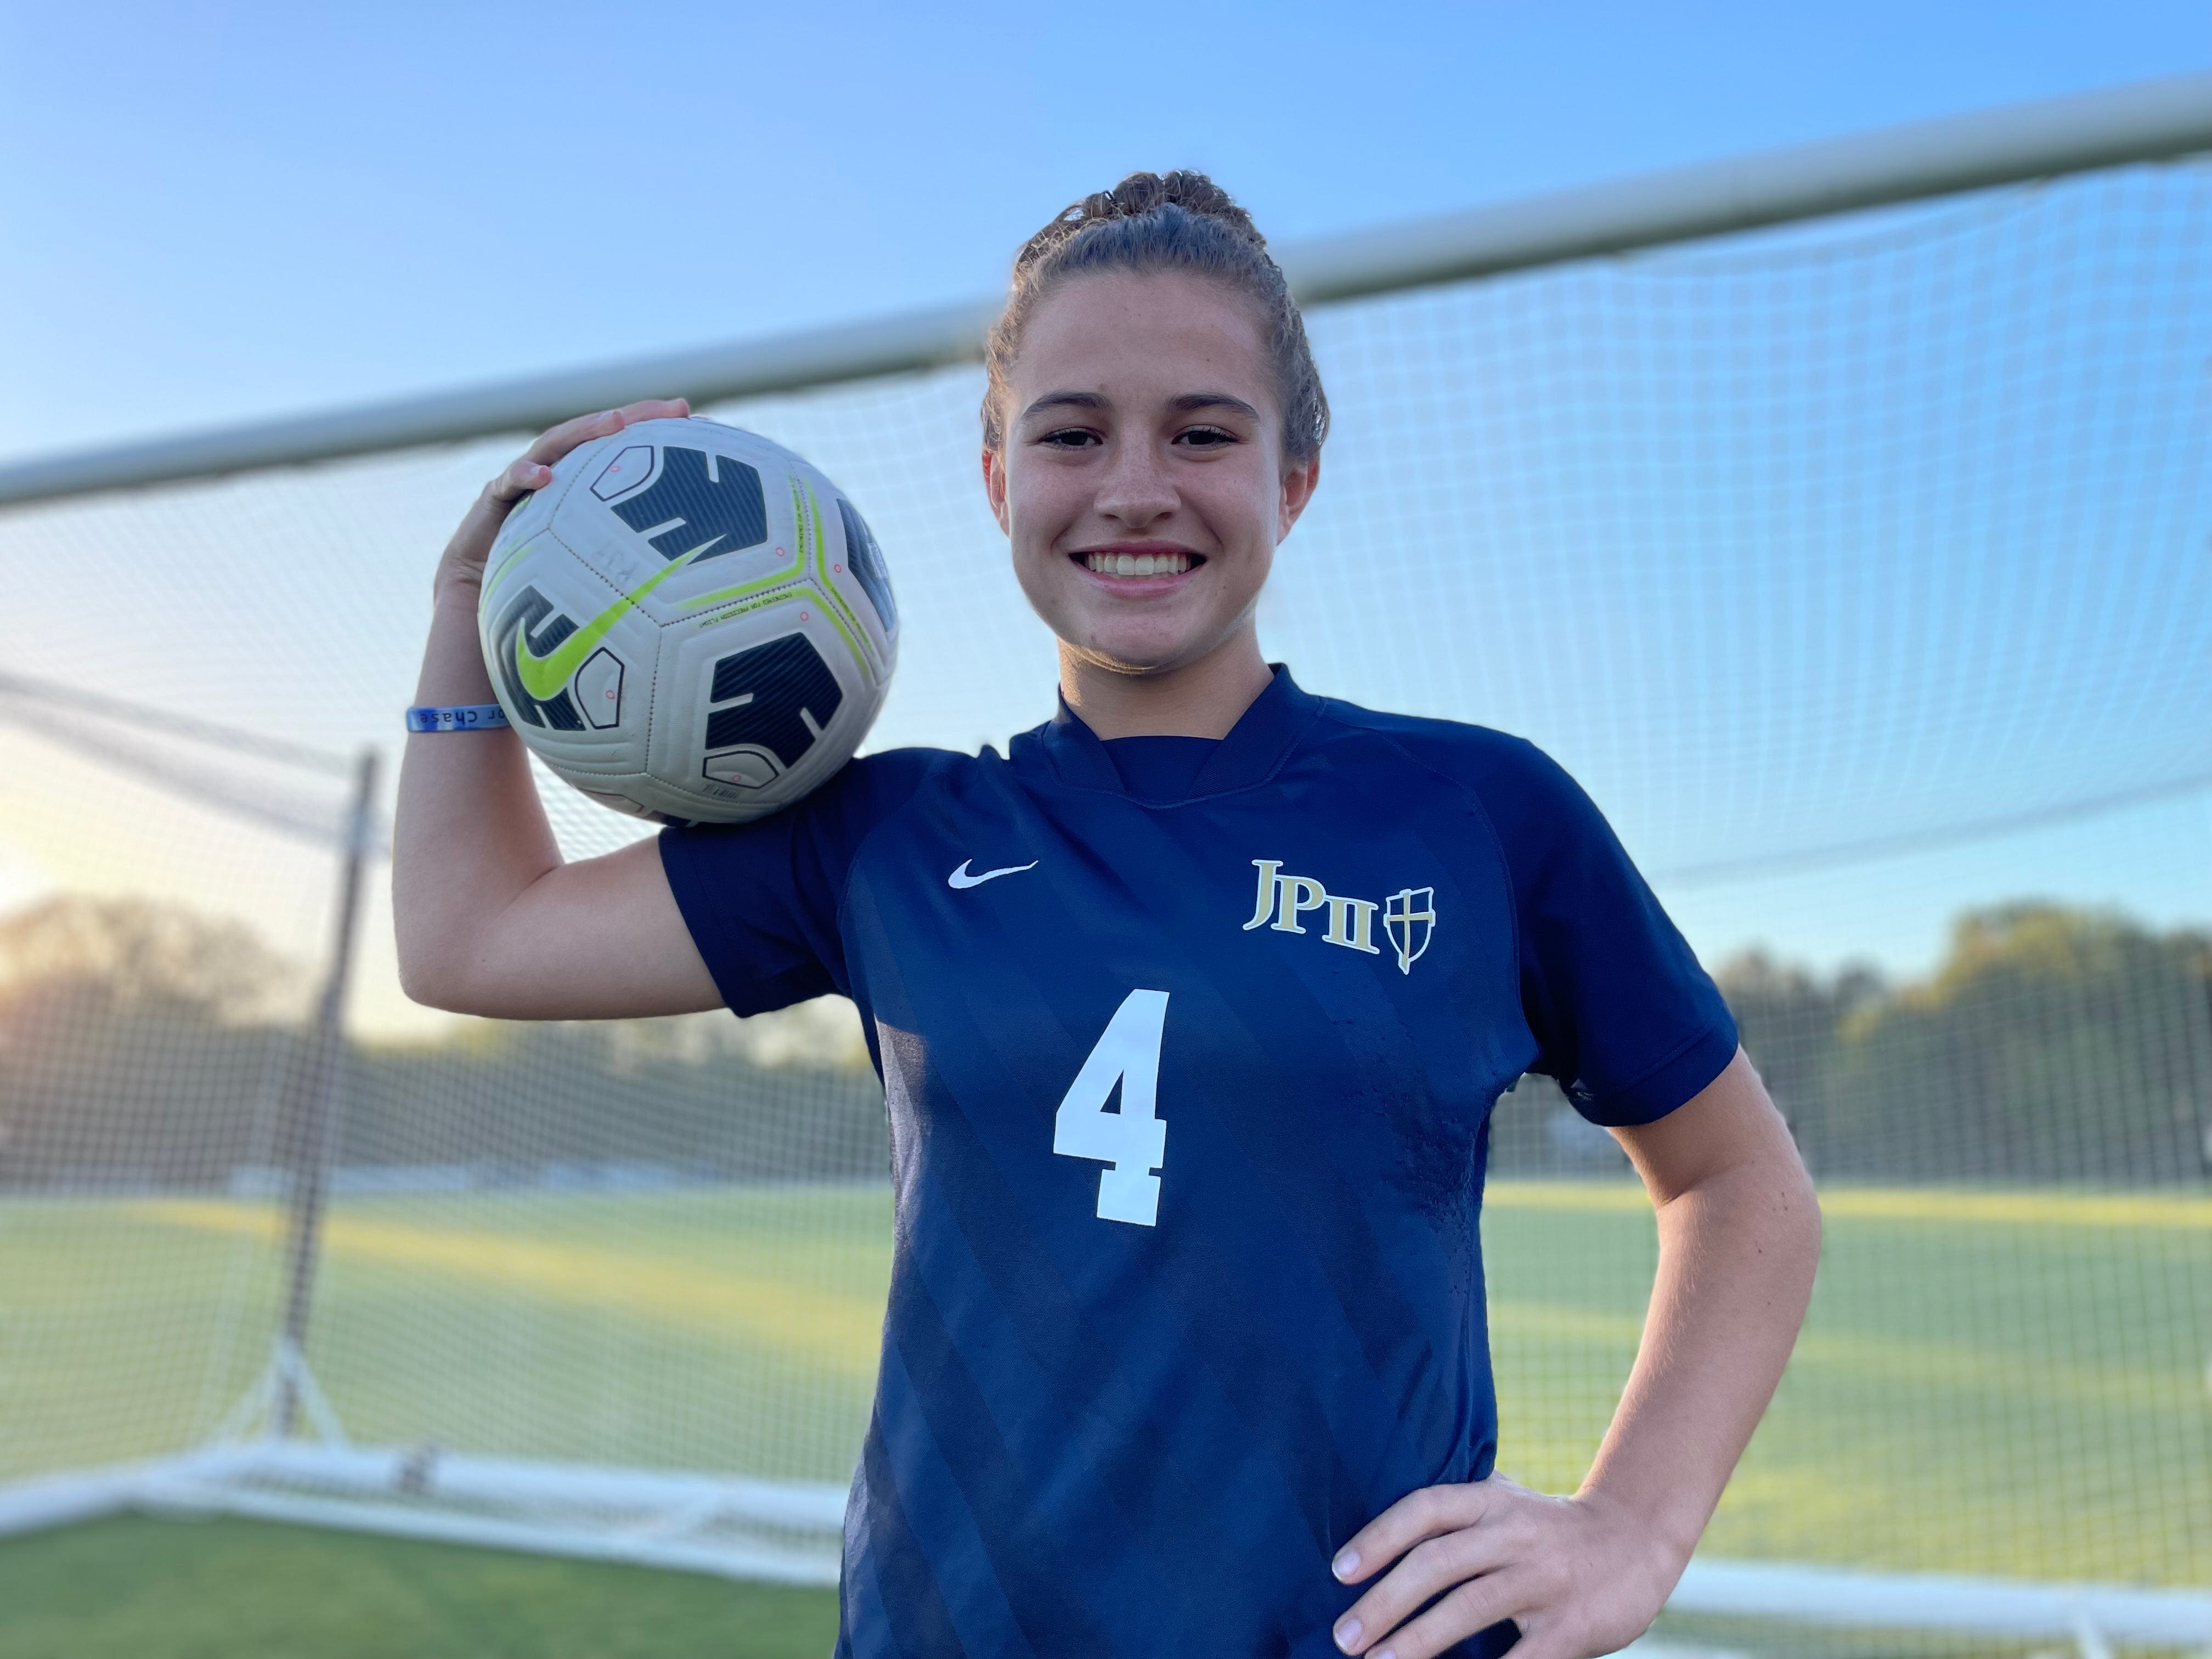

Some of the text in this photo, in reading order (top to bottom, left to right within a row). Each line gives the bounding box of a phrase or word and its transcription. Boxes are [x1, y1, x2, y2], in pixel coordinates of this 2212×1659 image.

[763, 592, 793, 605] ENGINEERED
[720, 607, 749, 620] PRECISION
[699, 617, 719, 628] FLIGHT
[420, 711, 477, 724] Chase
[1053, 988, 1170, 1226] 4
